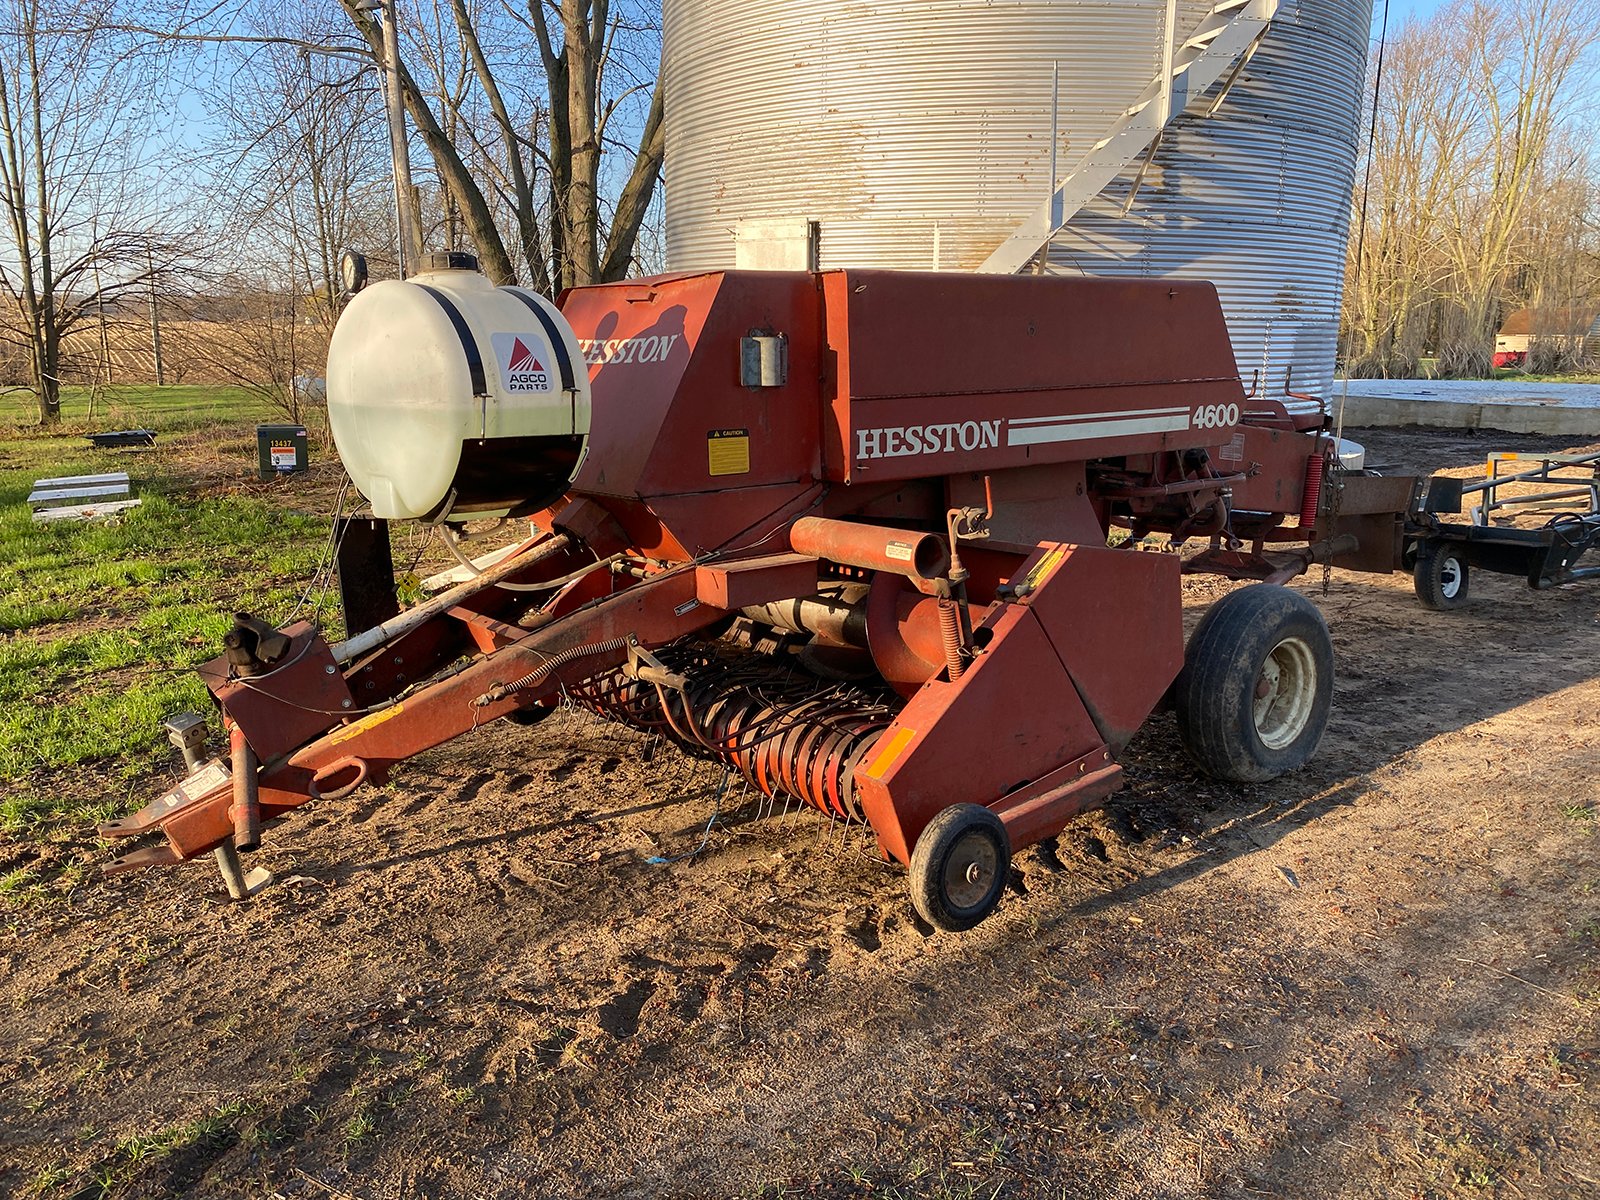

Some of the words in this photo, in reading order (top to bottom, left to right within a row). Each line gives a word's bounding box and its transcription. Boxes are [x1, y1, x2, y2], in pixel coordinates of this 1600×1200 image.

[510, 374, 547, 383] AGCO
[856, 419, 1002, 460] HESSTON
[1191, 402, 1240, 429] 4600
